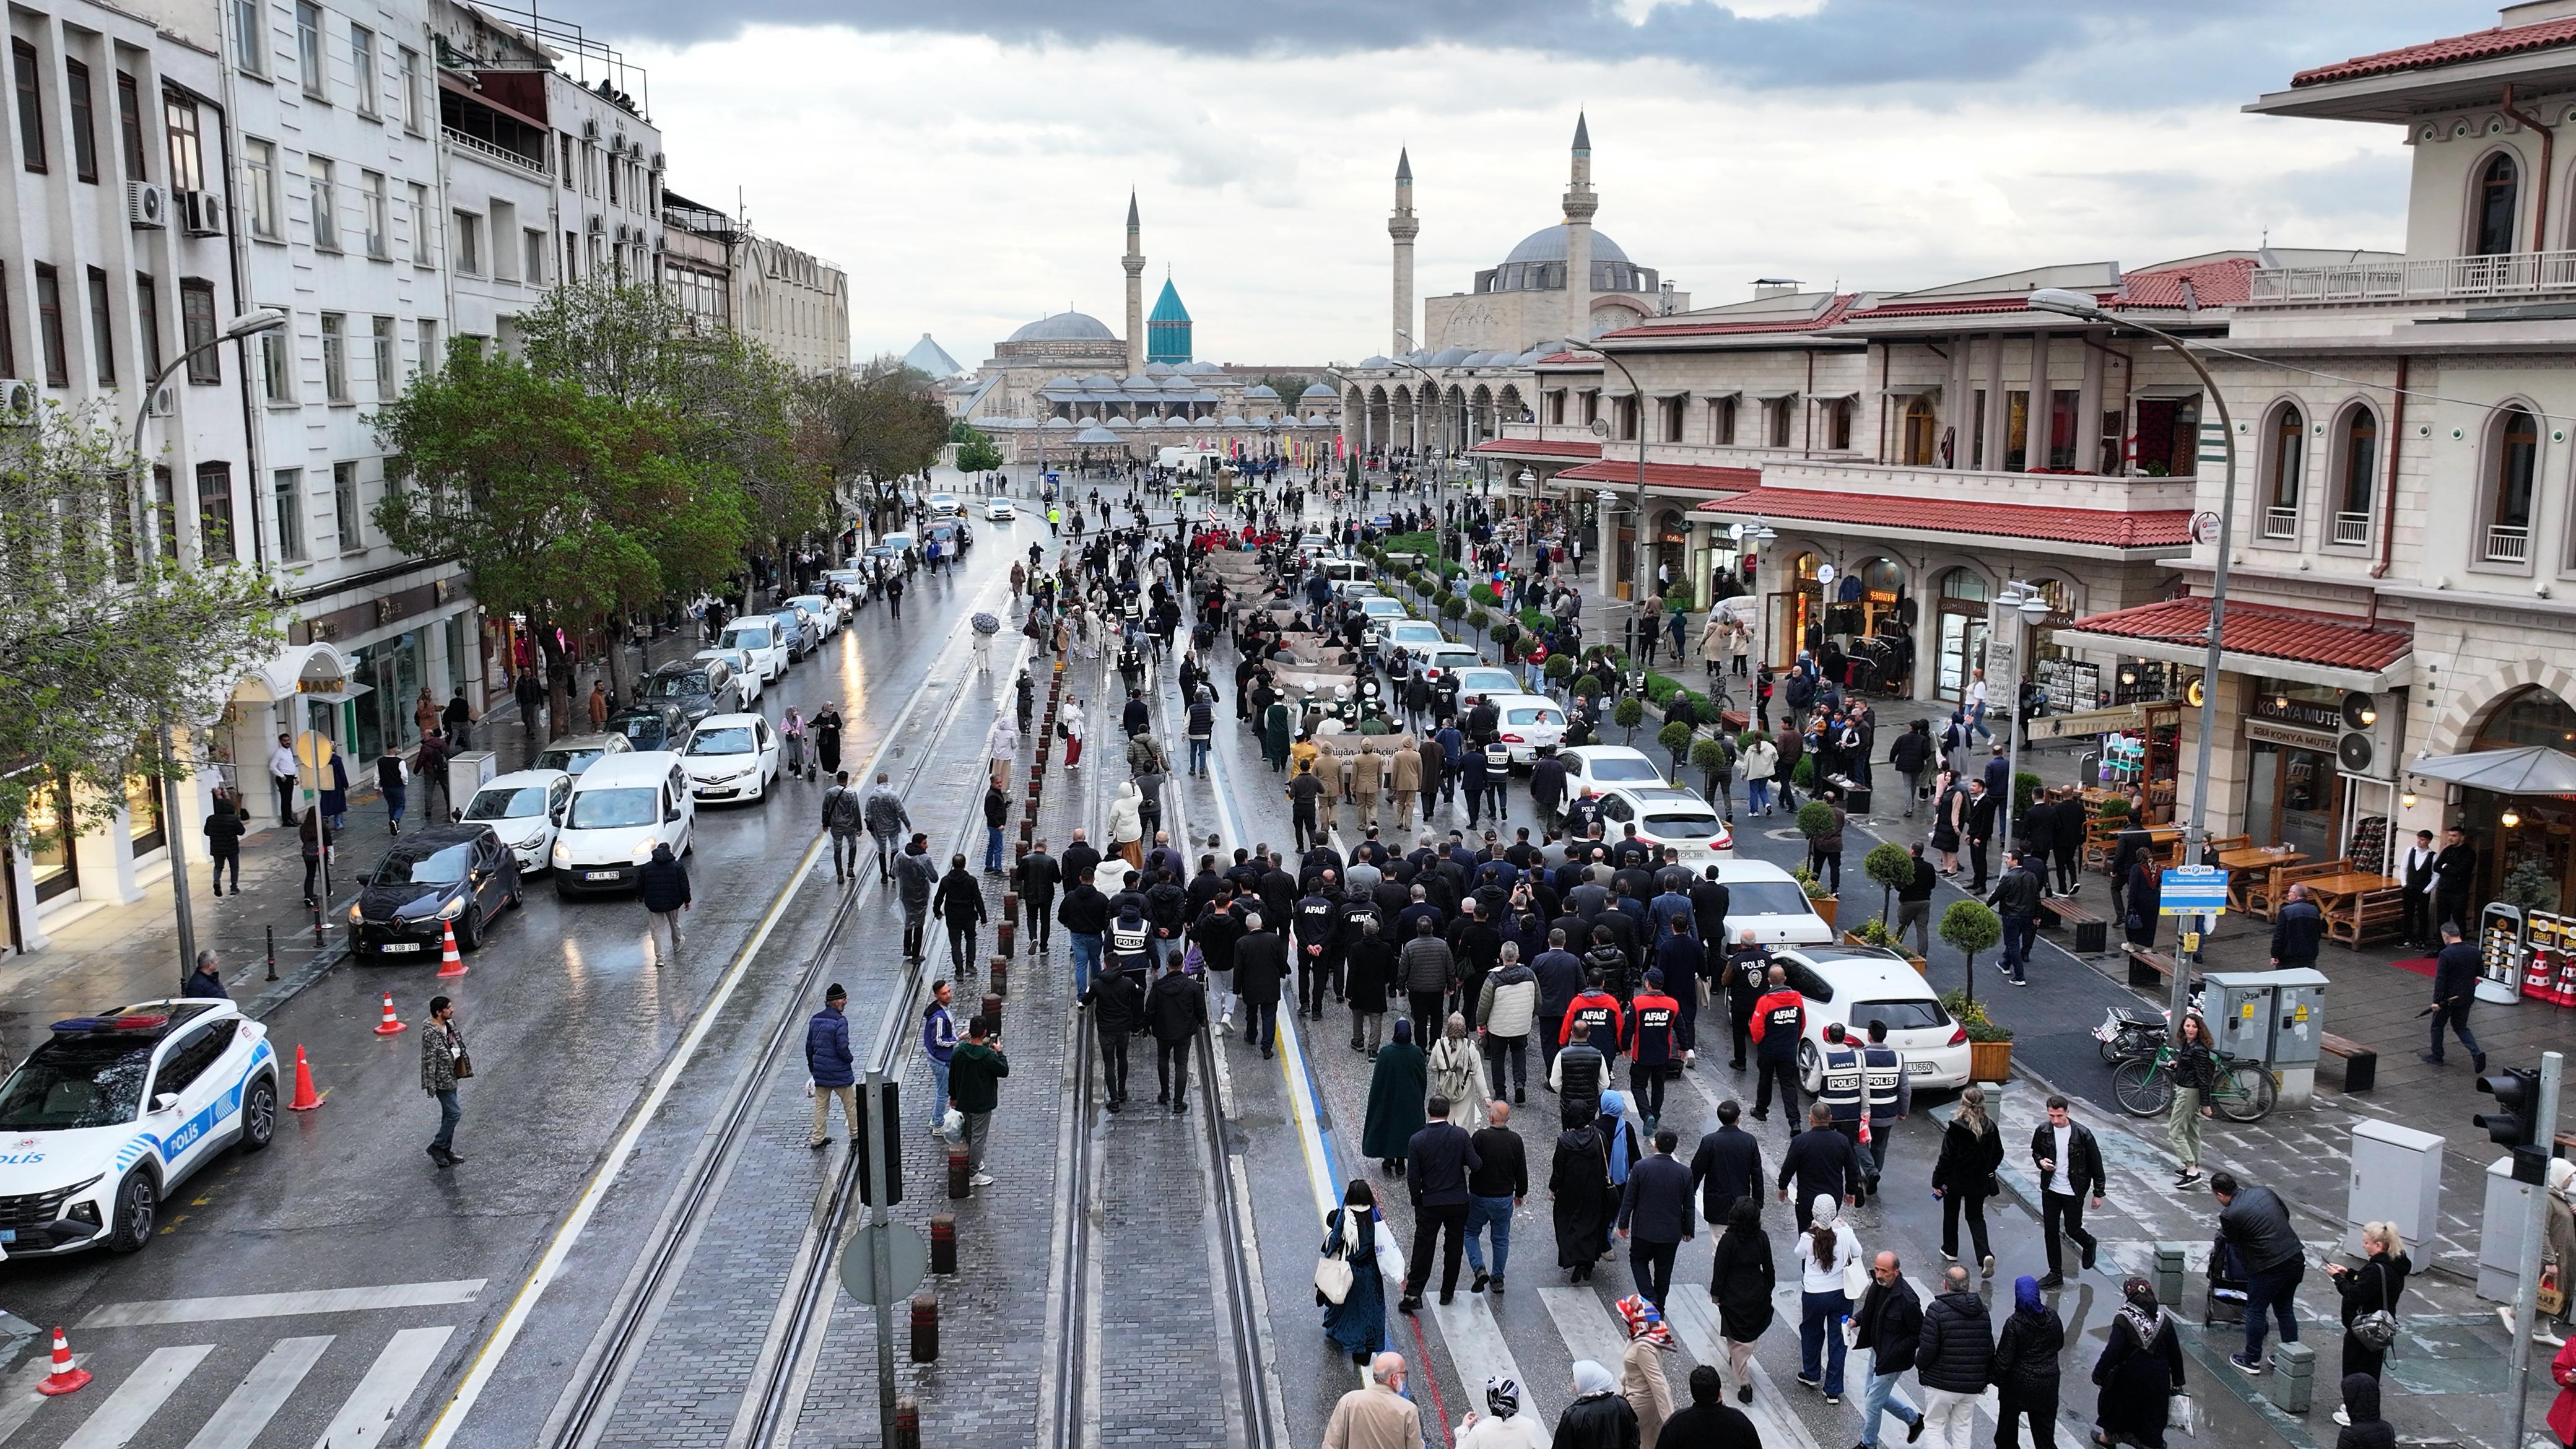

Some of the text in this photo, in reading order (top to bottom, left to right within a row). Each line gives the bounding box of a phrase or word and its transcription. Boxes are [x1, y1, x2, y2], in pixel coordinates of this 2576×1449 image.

[391, 603, 402, 614] TEB
[2271, 728, 2303, 743] KONYA
[1305, 906, 1326, 914] AFAD
[1351, 914, 1371, 923] AFAD
[1582, 1011, 1606, 1020] AFAD
[1644, 1012, 1669, 1021] AFAD
[1774, 1009, 1797, 1020] AFAD
[171, 1123, 199, 1155] POLİS
[0, 1152, 46, 1164] OLİS
